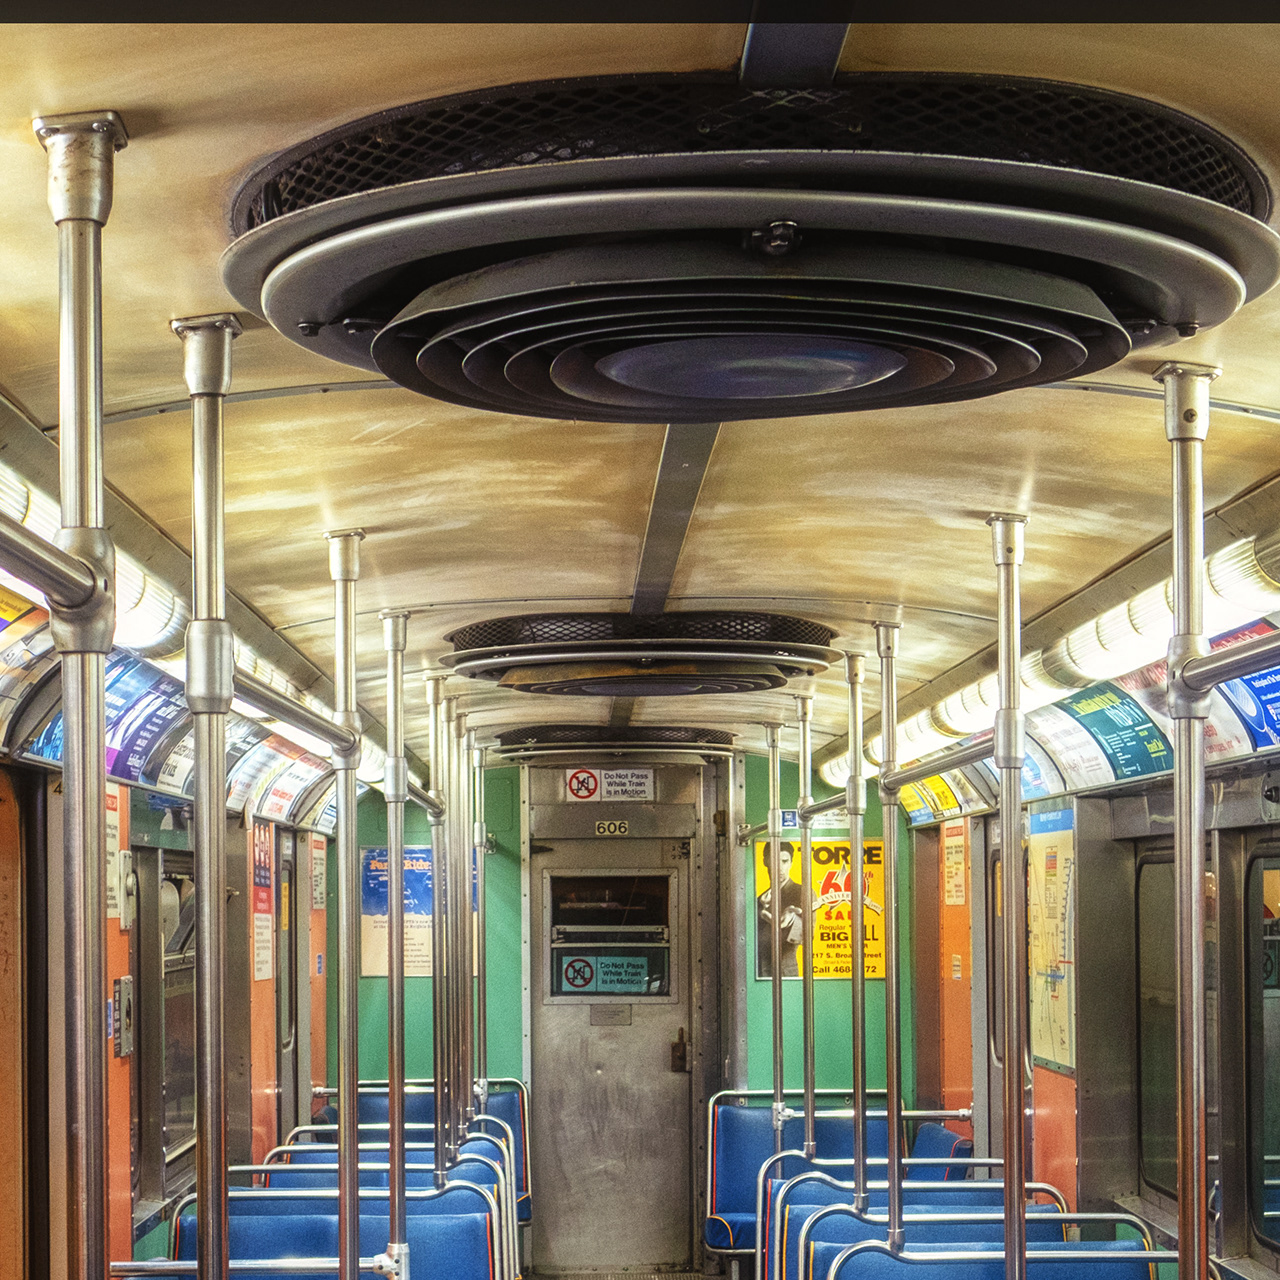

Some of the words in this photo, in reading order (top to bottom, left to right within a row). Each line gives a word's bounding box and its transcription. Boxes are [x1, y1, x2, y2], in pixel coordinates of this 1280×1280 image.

[604, 772, 615, 780] Do
[615, 772, 629, 780] Not
[630, 772, 649, 780] Pass
[606, 780, 627, 788] While
[628, 780, 646, 788] Train
[620, 788, 646, 796] Motion
[596, 821, 628, 835] 606
[819, 932, 849, 941] BIG
[600, 961, 612, 970] Do
[611, 961, 625, 970] Not
[626, 961, 645, 970] Pass
[813, 965, 831, 974] Call
[602, 969, 623, 977] While
[616, 977, 642, 985] Motion
